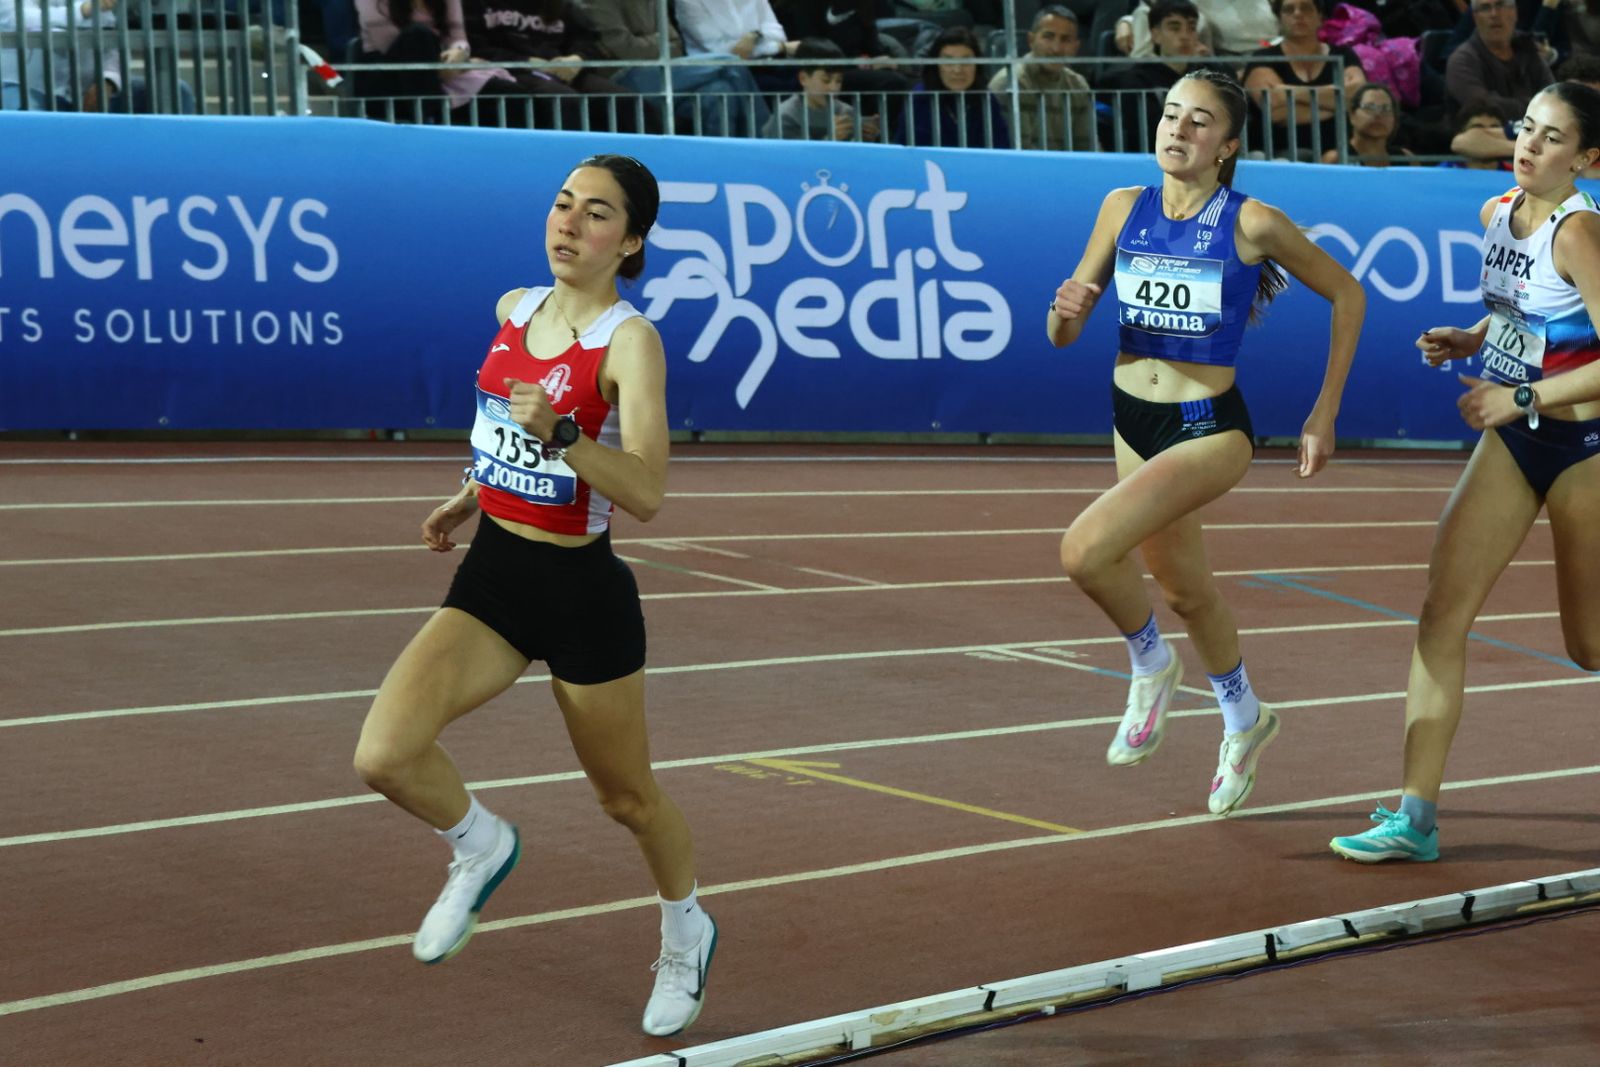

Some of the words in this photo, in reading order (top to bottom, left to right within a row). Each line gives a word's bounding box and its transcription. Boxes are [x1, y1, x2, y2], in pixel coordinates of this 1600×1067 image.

[1485, 243, 1536, 281] CAPEX
[1135, 280, 1191, 310] 420
[74, 308, 344, 345] SOLUTIONS
[494, 426, 542, 469] 155
